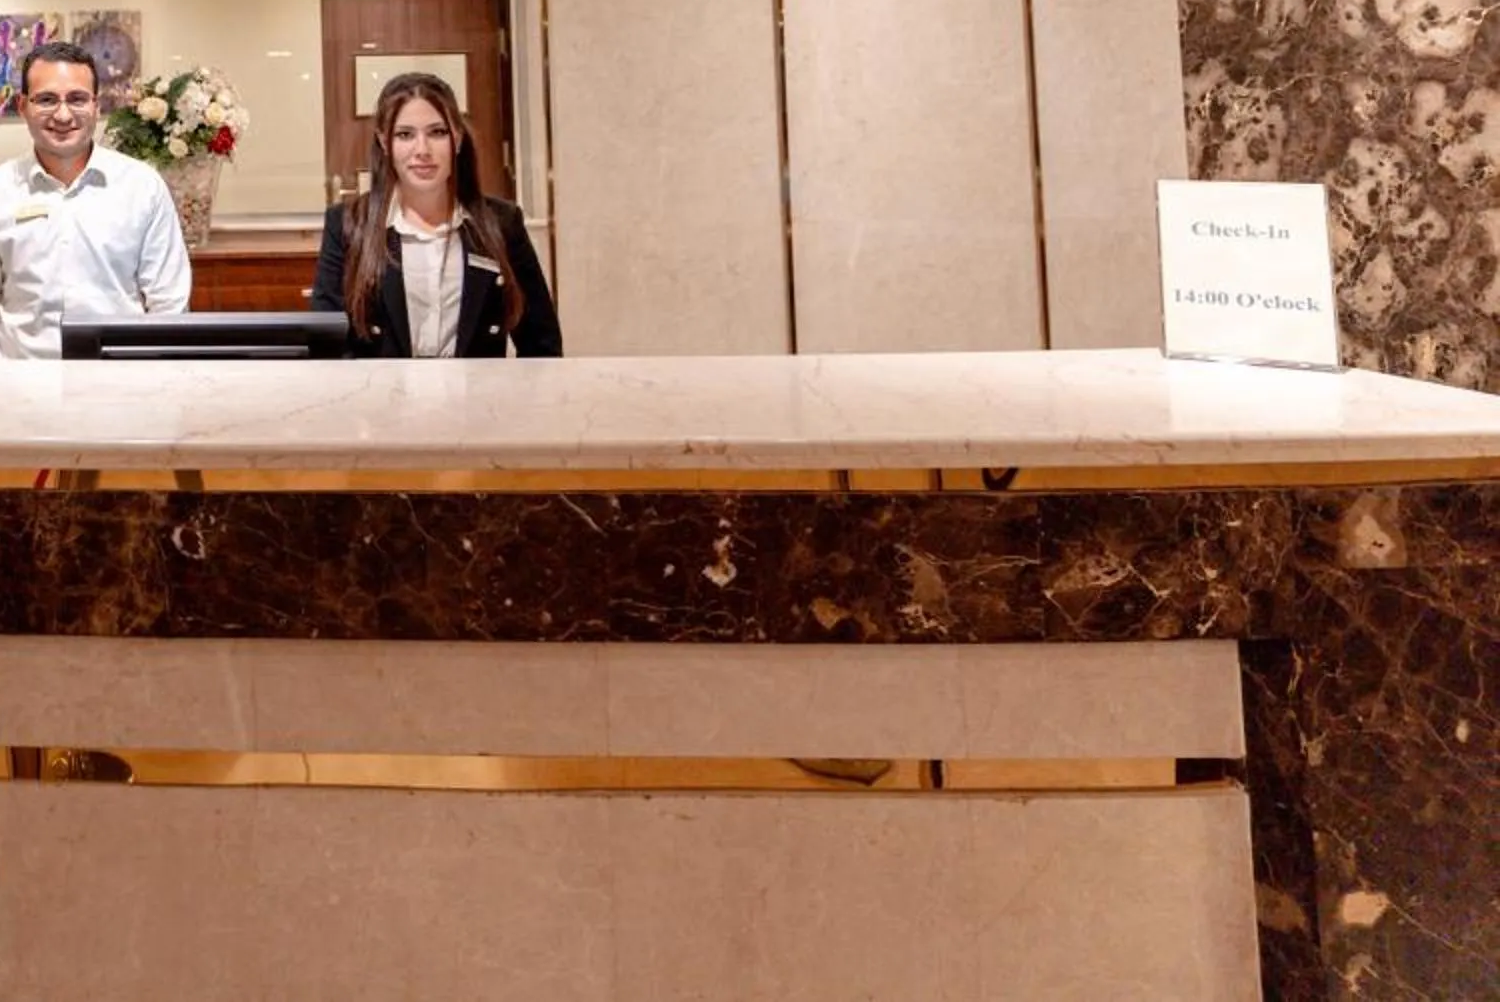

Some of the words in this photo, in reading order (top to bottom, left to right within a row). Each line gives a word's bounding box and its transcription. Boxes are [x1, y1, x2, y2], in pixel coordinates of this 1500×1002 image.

[1191, 220, 1290, 240] Check-In
[1174, 288, 1229, 306] 14:00
[1236, 292, 1322, 312] O'clock
